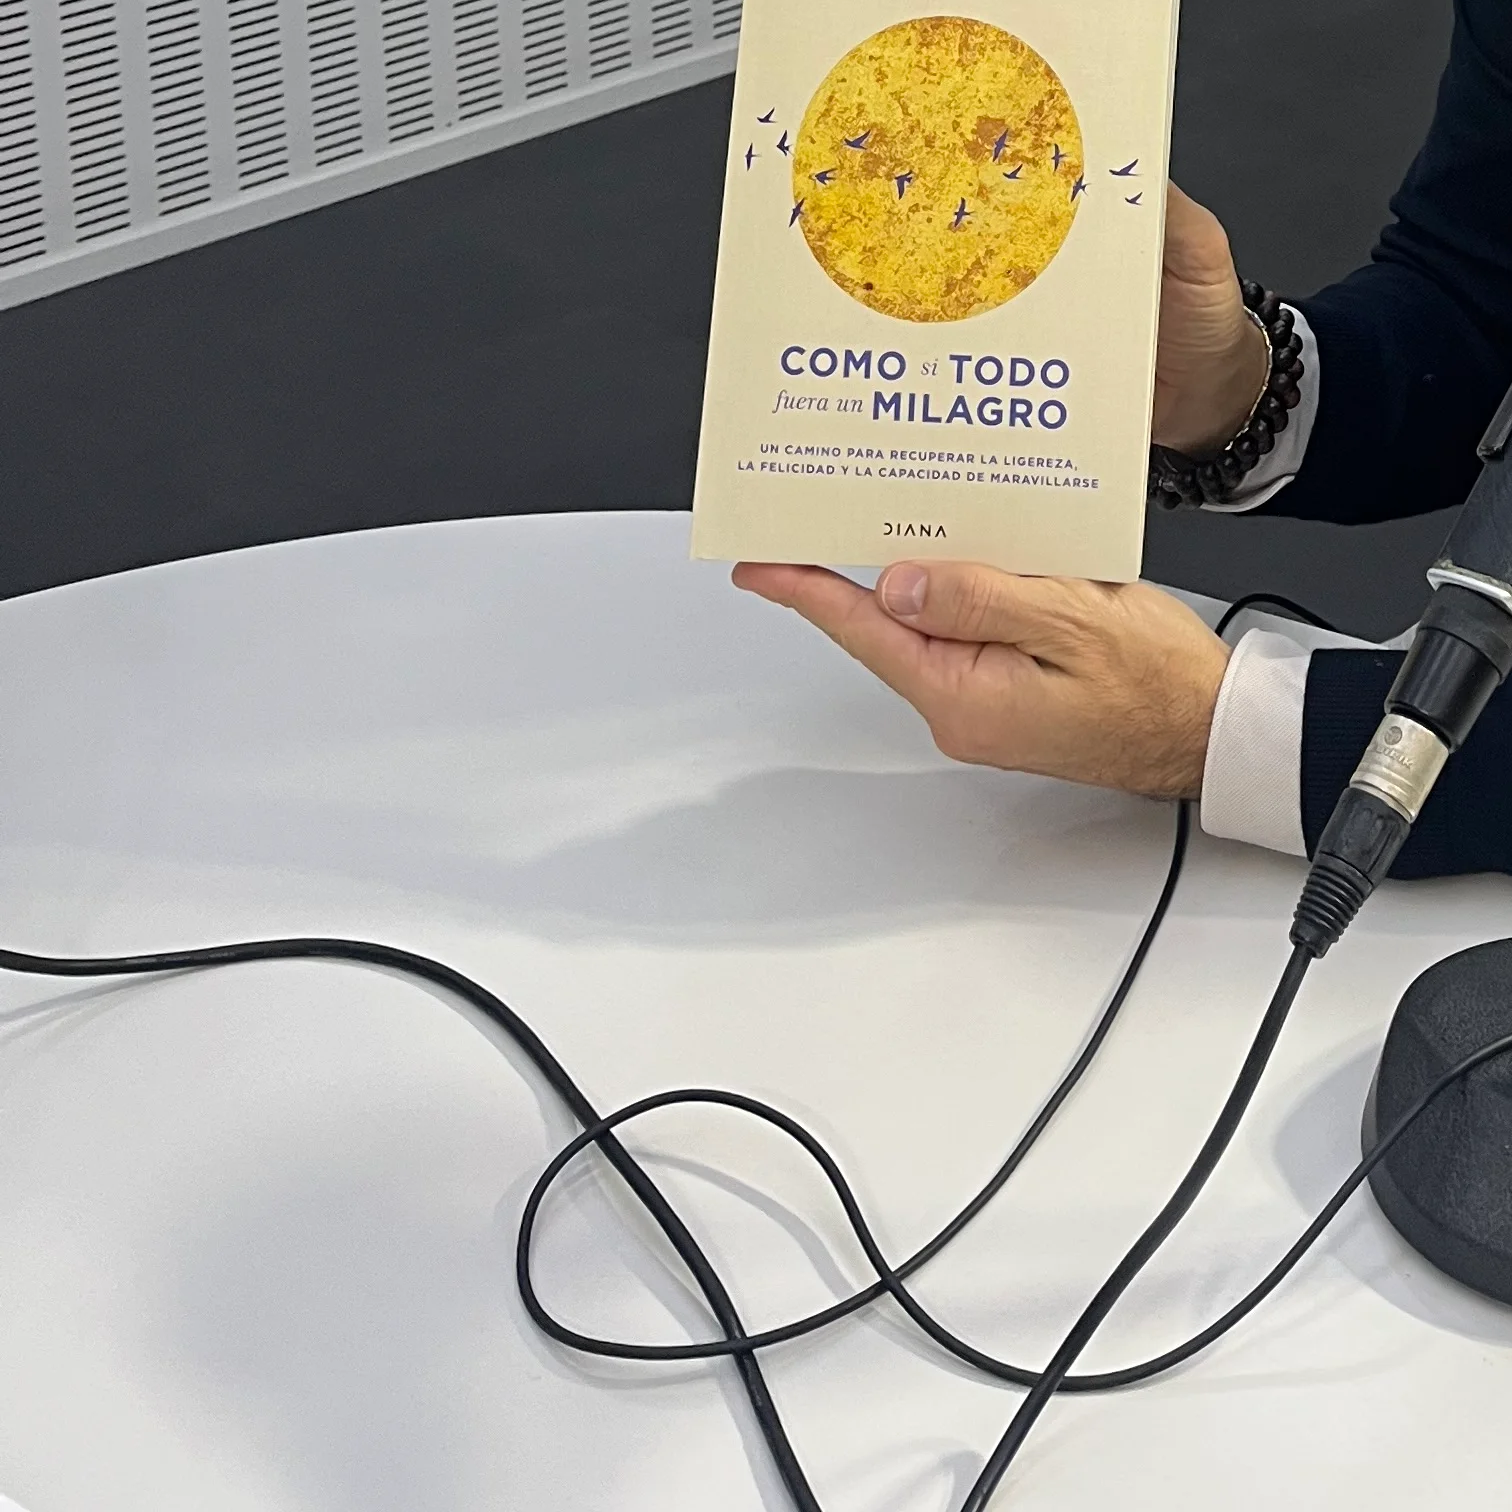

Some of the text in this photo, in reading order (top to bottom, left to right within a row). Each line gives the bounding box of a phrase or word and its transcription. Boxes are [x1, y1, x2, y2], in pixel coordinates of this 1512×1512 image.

[780, 345, 1070, 389] COMO si TODO
[772, 389, 1068, 430] fuera un MILAGRO
[760, 444, 1078, 471] UN CAMINO PARA RECUPERAR LA LIGEREZA,
[737, 460, 1100, 489] LA FELICIDAD Y LA CAPACIDAD DE MARAVILLARSE
[883, 522, 947, 539] DIANA
